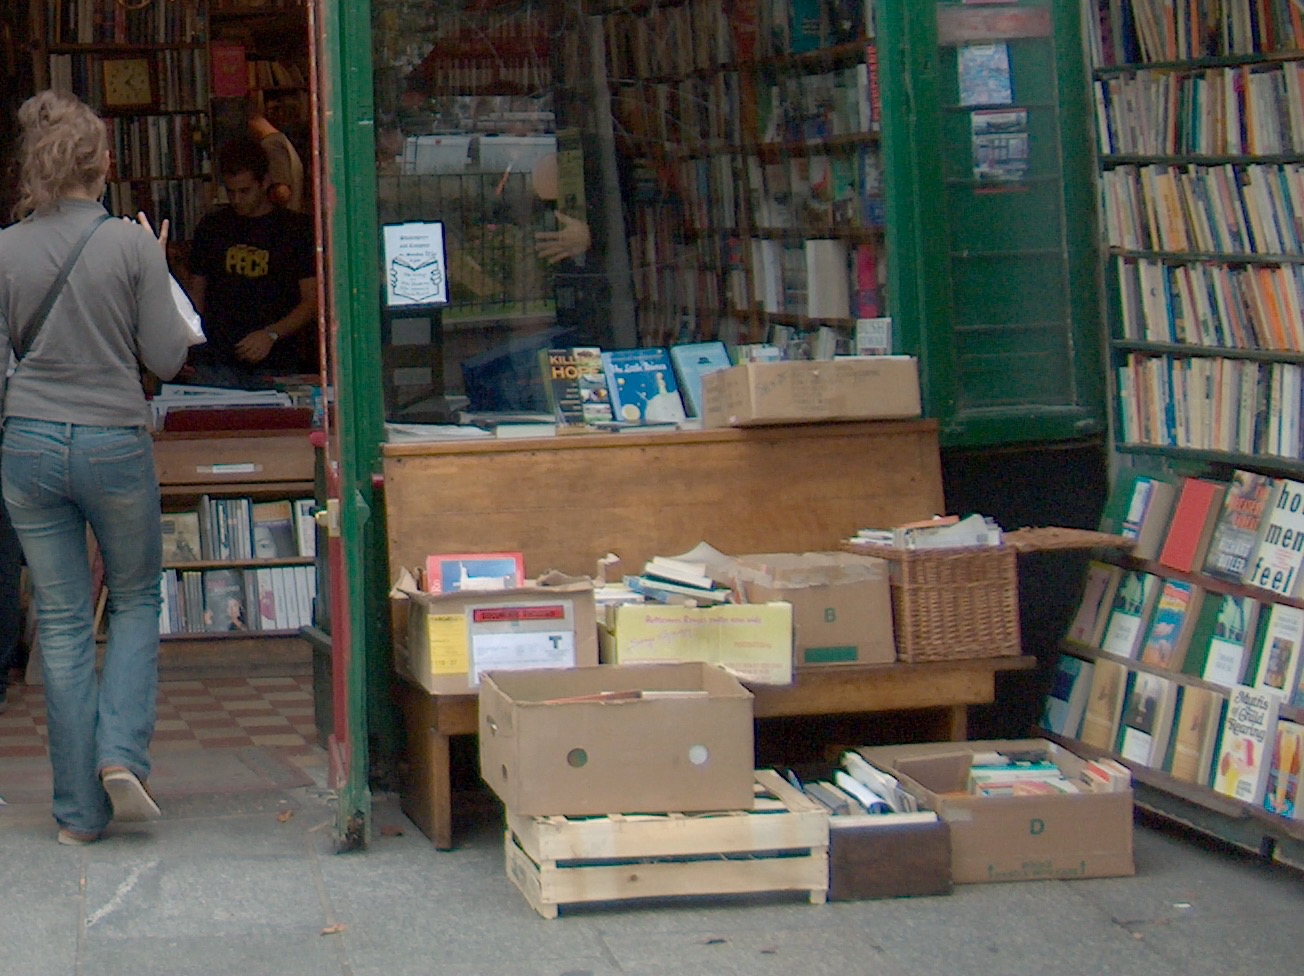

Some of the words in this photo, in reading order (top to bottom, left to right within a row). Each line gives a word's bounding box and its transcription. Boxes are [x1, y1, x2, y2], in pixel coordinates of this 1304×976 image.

[1277, 482, 1304, 515] ho
[1251, 556, 1295, 594] feel
[1030, 818, 1045, 835] D
